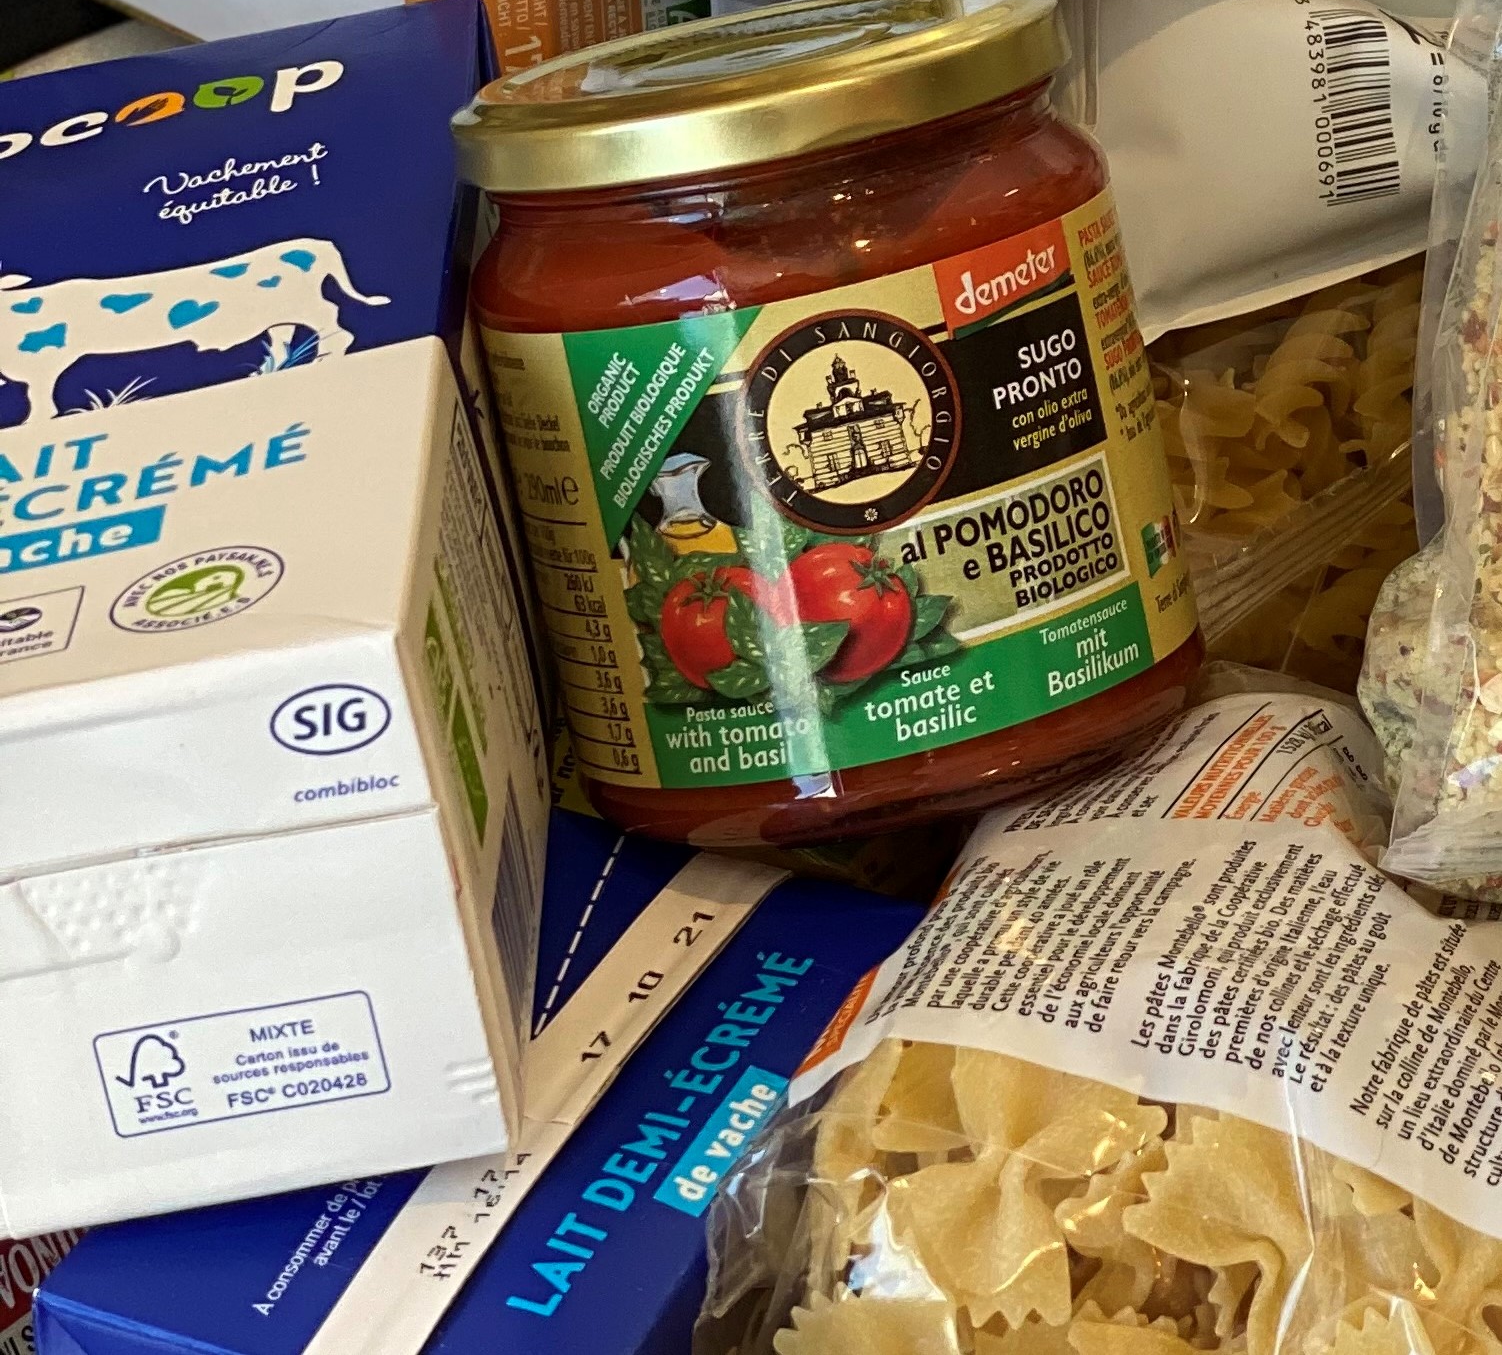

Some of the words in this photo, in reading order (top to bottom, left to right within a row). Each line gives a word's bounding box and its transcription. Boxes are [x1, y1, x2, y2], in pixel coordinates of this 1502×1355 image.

[1304, 19, 1327, 104] 483981
[143, 142, 328, 194] Vachement
[1315, 116, 1335, 199] 000691
[159, 175, 298, 224] équitable
[955, 244, 1056, 314] demeter
[1017, 328, 1076, 369] SUGO
[588, 352, 628, 415] ORGANIC
[598, 362, 642, 429] PRODUCT
[992, 358, 1082, 410] PRONTO
[1012, 407, 1035, 428] con
[1038, 399, 1059, 418] olio
[1061, 388, 1088, 410] extra
[600, 421, 635, 481] PRODUIT
[632, 343, 686, 425] BIOLOGIQUE
[613, 414, 672, 509] BIOLOGISCHES
[664, 347, 716, 421] PRODUKT
[1012, 424, 1056, 450] vergine
[901, 530, 927, 566] al
[933, 469, 1104, 555] POMODORO
[962, 557, 981, 580] e
[986, 502, 1110, 574] BASILICO
[1009, 533, 1113, 588] PRODOTTO
[1015, 552, 1118, 607] BIOLOGICO
[1039, 598, 1128, 644] Tomatensauce
[1076, 627, 1108, 659] mit
[900, 664, 951, 688] Sauce
[1048, 643, 1139, 696] Basilikum
[293, 697, 367, 741] SIG
[686, 706, 726, 722] Pasta
[730, 701, 774, 719] sauce
[864, 683, 961, 722] tomate
[969, 671, 995, 694] et
[666, 724, 712, 748] with
[719, 718, 810, 745] tomato
[896, 703, 977, 742] basilic
[690, 751, 729, 773] and
[738, 743, 791, 768] basil
[293, 773, 400, 803] combibloc
[580, 1031, 612, 1063] 17
[629, 970, 664, 1003] 10
[673, 911, 715, 946] 21
[1178, 966, 1224, 1056] Girolomoni,
[236, 1050, 283, 1066] Carton
[288, 1046, 318, 1058] issu
[322, 1041, 339, 1053] de
[249, 1019, 315, 1043] MIXTE
[213, 1066, 270, 1084] sources
[274, 1051, 369, 1076] responsables
[282, 1073, 367, 1099] C020428
[1350, 1076, 1382, 1116] Notre
[1372, 1026, 1413, 1079] fabrique
[135, 1088, 194, 1113] FSC
[138, 1106, 199, 1124] www.fsc.org
[506, 1213, 610, 1318] LAIT
[582, 952, 814, 1211] DEMI-ÉCRÉMÉ
[673, 1162, 718, 1202] de
[705, 1082, 777, 1167] vache
[267, 1211, 331, 1301] consommer
[313, 1217, 350, 1267] avant
